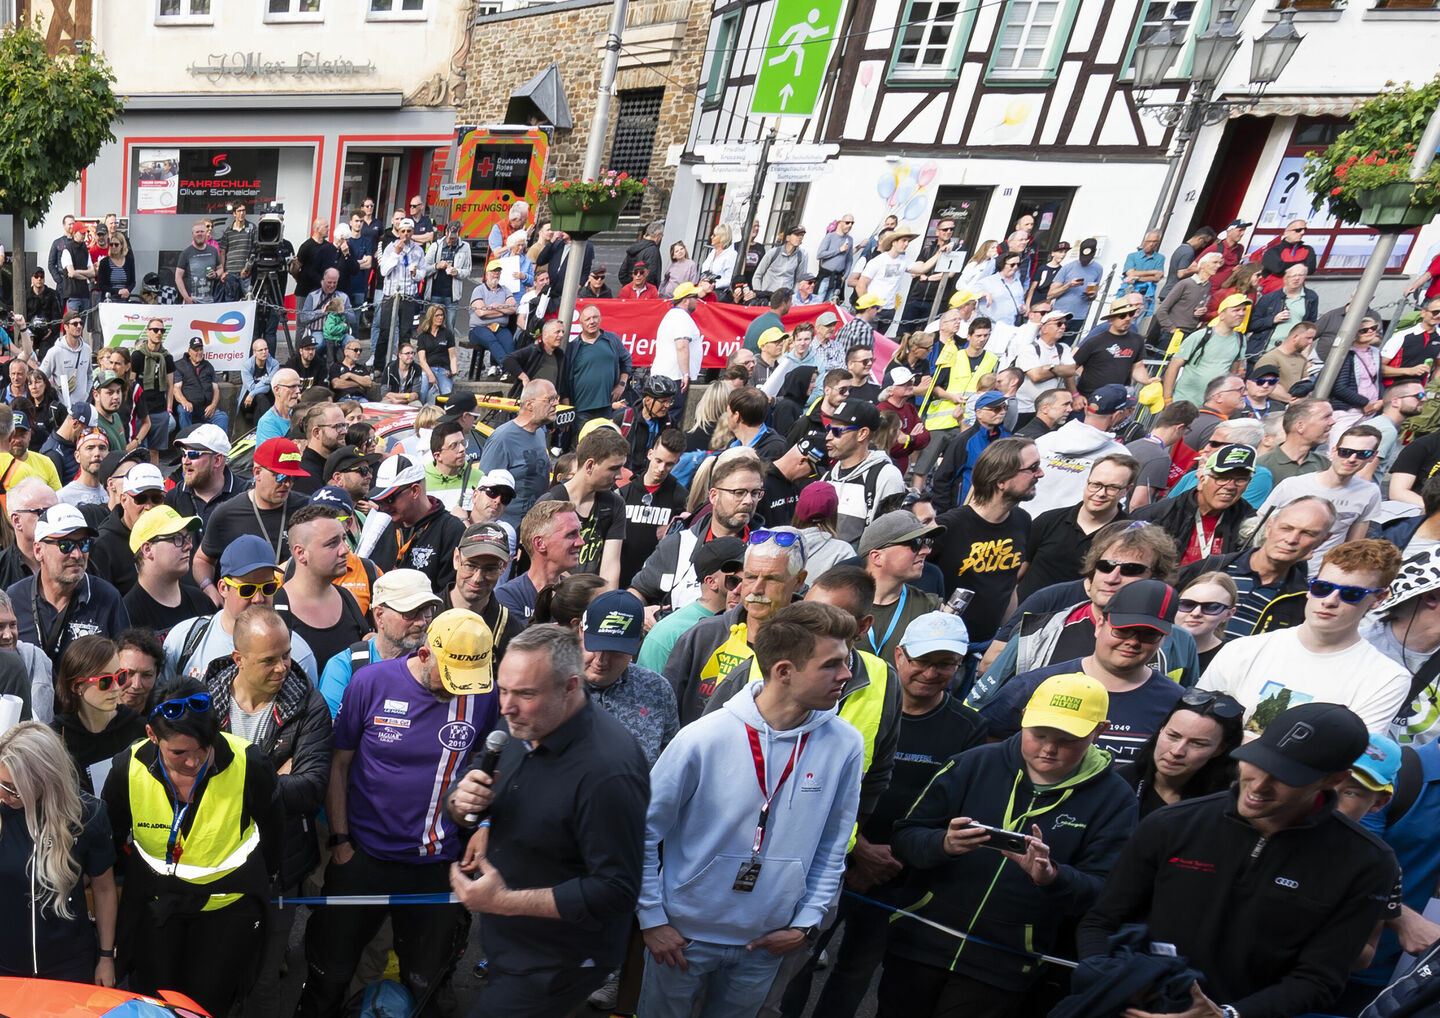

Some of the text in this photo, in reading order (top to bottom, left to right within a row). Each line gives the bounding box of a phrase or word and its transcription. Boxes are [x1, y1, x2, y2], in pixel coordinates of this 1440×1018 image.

[497, 158, 527, 166] Deutsches
[179, 180, 262, 190] FAHRSCHULE
[179, 189, 261, 199] Oliver Schneider
[455, 201, 534, 214] RETTUNGSDIT
[624, 505, 672, 525] PUMA
[973, 538, 1014, 558] RING
[961, 553, 1021, 578] POLICE
[600, 616, 634, 630] 24
[1054, 694, 1083, 704] MANN
[1050, 700, 1080, 712] FILTER
[1109, 726, 1131, 735] 1949
[448, 741, 466, 751] 2019
